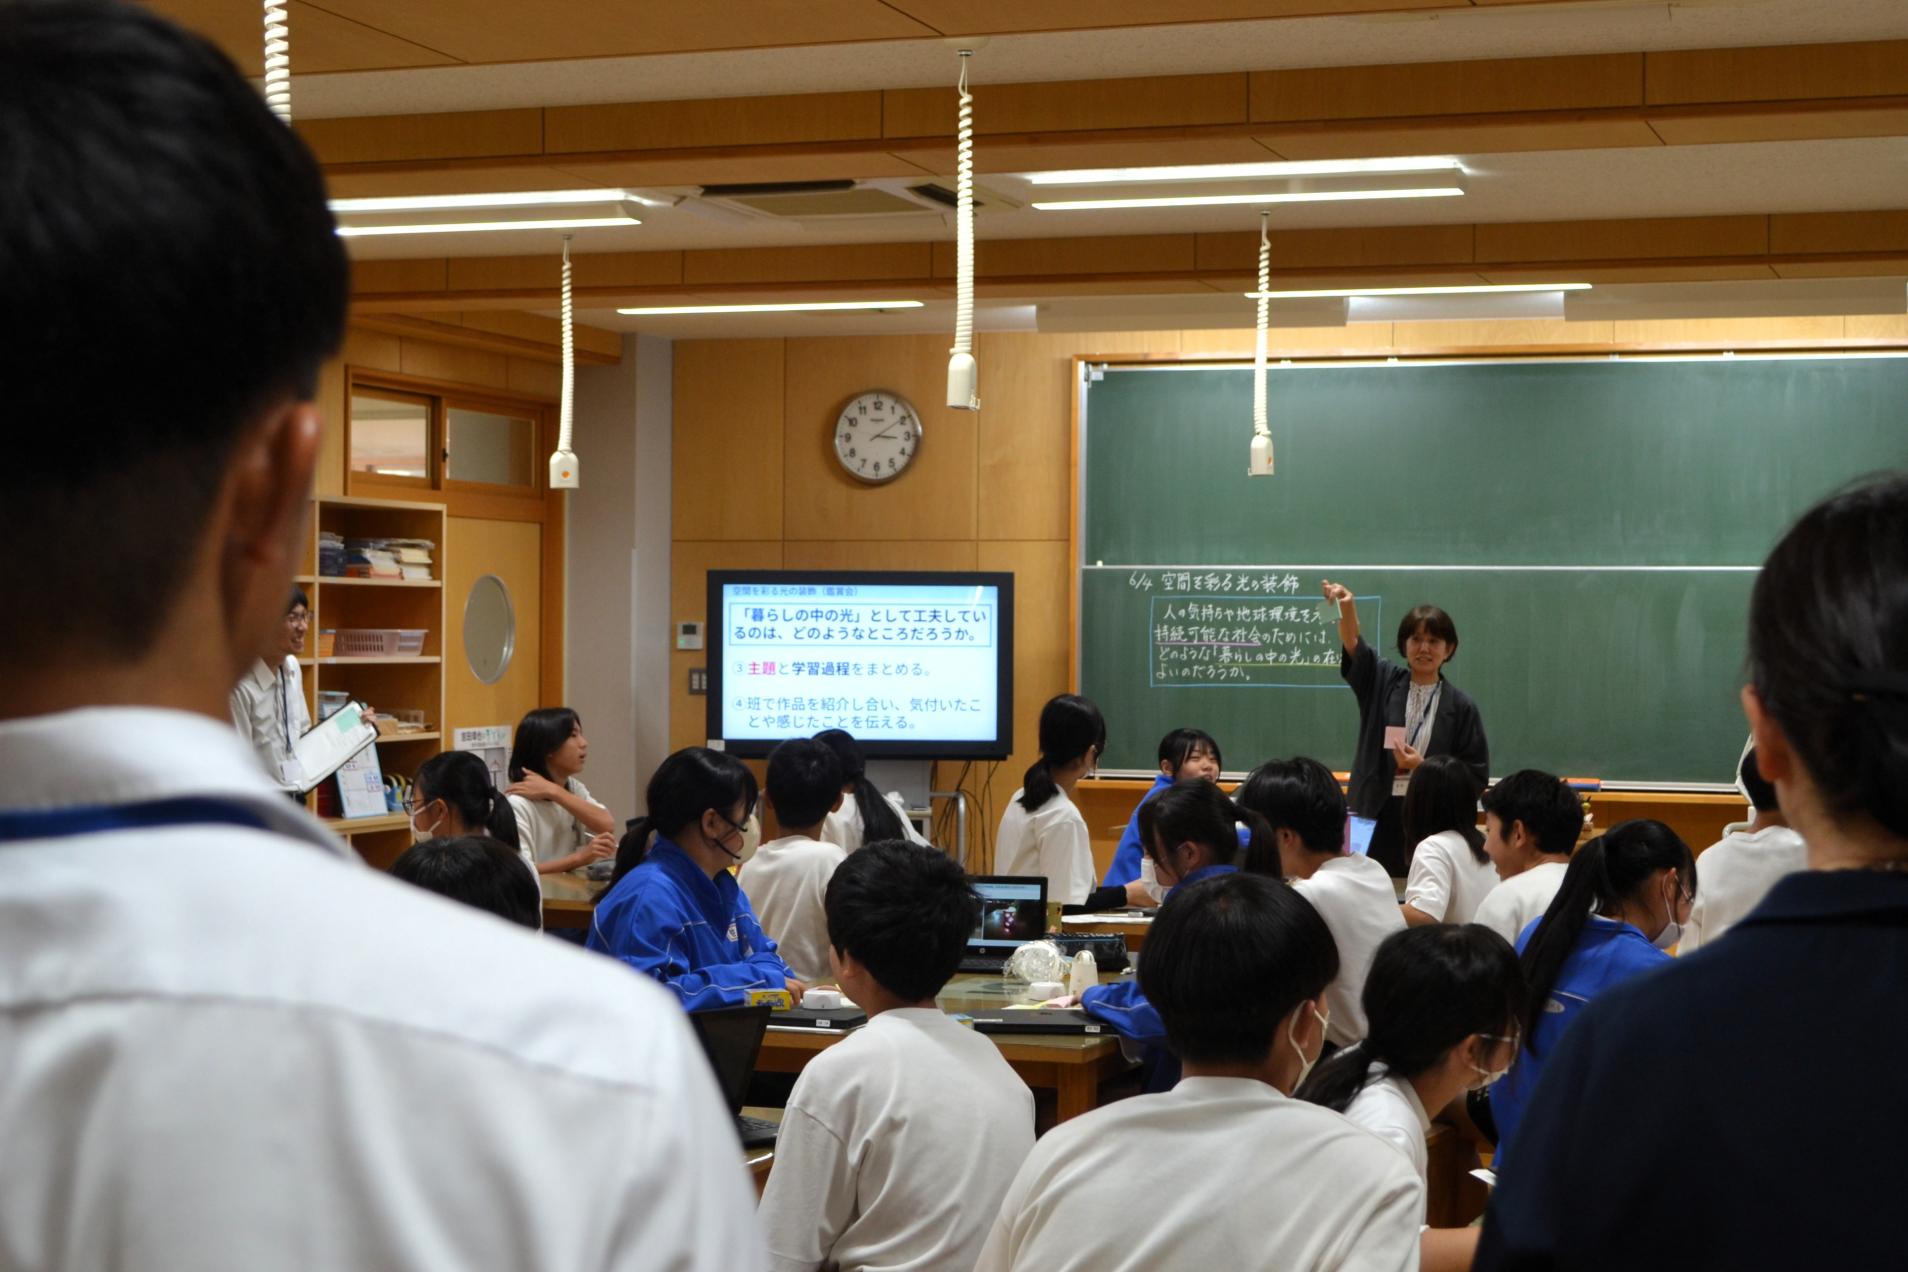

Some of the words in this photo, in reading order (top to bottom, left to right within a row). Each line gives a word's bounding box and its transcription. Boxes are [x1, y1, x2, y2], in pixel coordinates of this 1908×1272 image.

[858, 405, 867, 416] 11
[873, 400, 883, 411] 12
[890, 405, 895, 416] 1
[848, 417, 858, 428] 10
[844, 432, 852, 443] 9
[904, 431, 911, 442] 3
[848, 448, 856, 458] 8
[899, 447, 906, 457] 4
[860, 458, 867, 468] 7
[873, 461, 880, 473] 6
[888, 457, 896, 468] 5
[1128, 570, 1153, 592] 6/4
[1161, 571, 1300, 595] 空間を彩る光の装飾
[742, 607, 987, 624] 「暮らしの中の光」として工夫してい
[733, 626, 977, 642] るのは、どのようなところだろうか。
[748, 715, 916, 730] とや感じたことを伝える。
